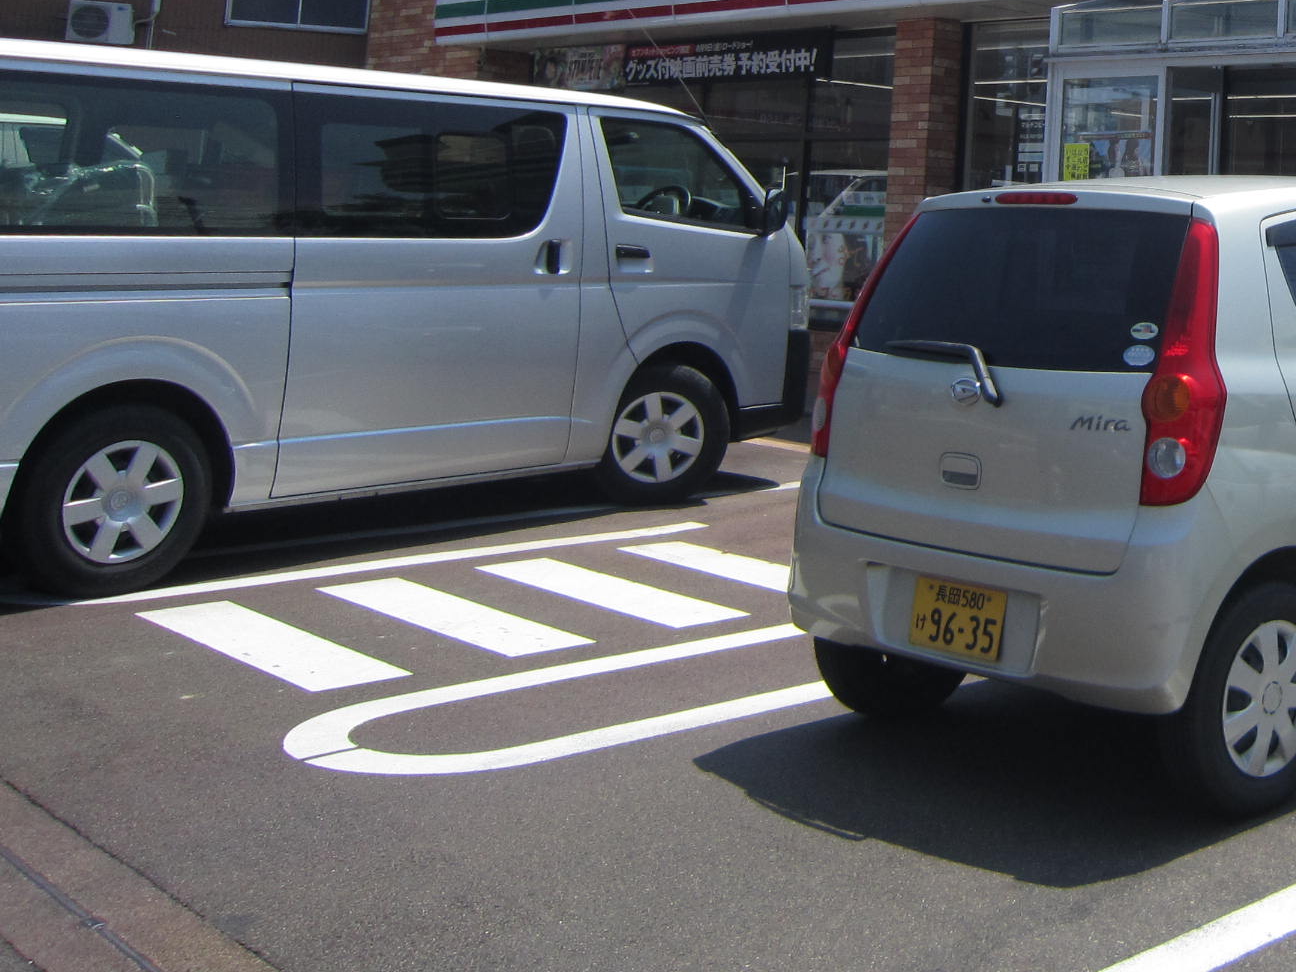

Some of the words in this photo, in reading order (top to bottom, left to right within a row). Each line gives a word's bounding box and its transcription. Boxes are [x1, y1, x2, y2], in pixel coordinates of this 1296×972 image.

[625, 54, 737, 80] グッズ付映画前売券
[739, 48, 817, 76] 予約受付中!
[1070, 414, 1132, 432] Mira
[915, 613, 927, 631] け
